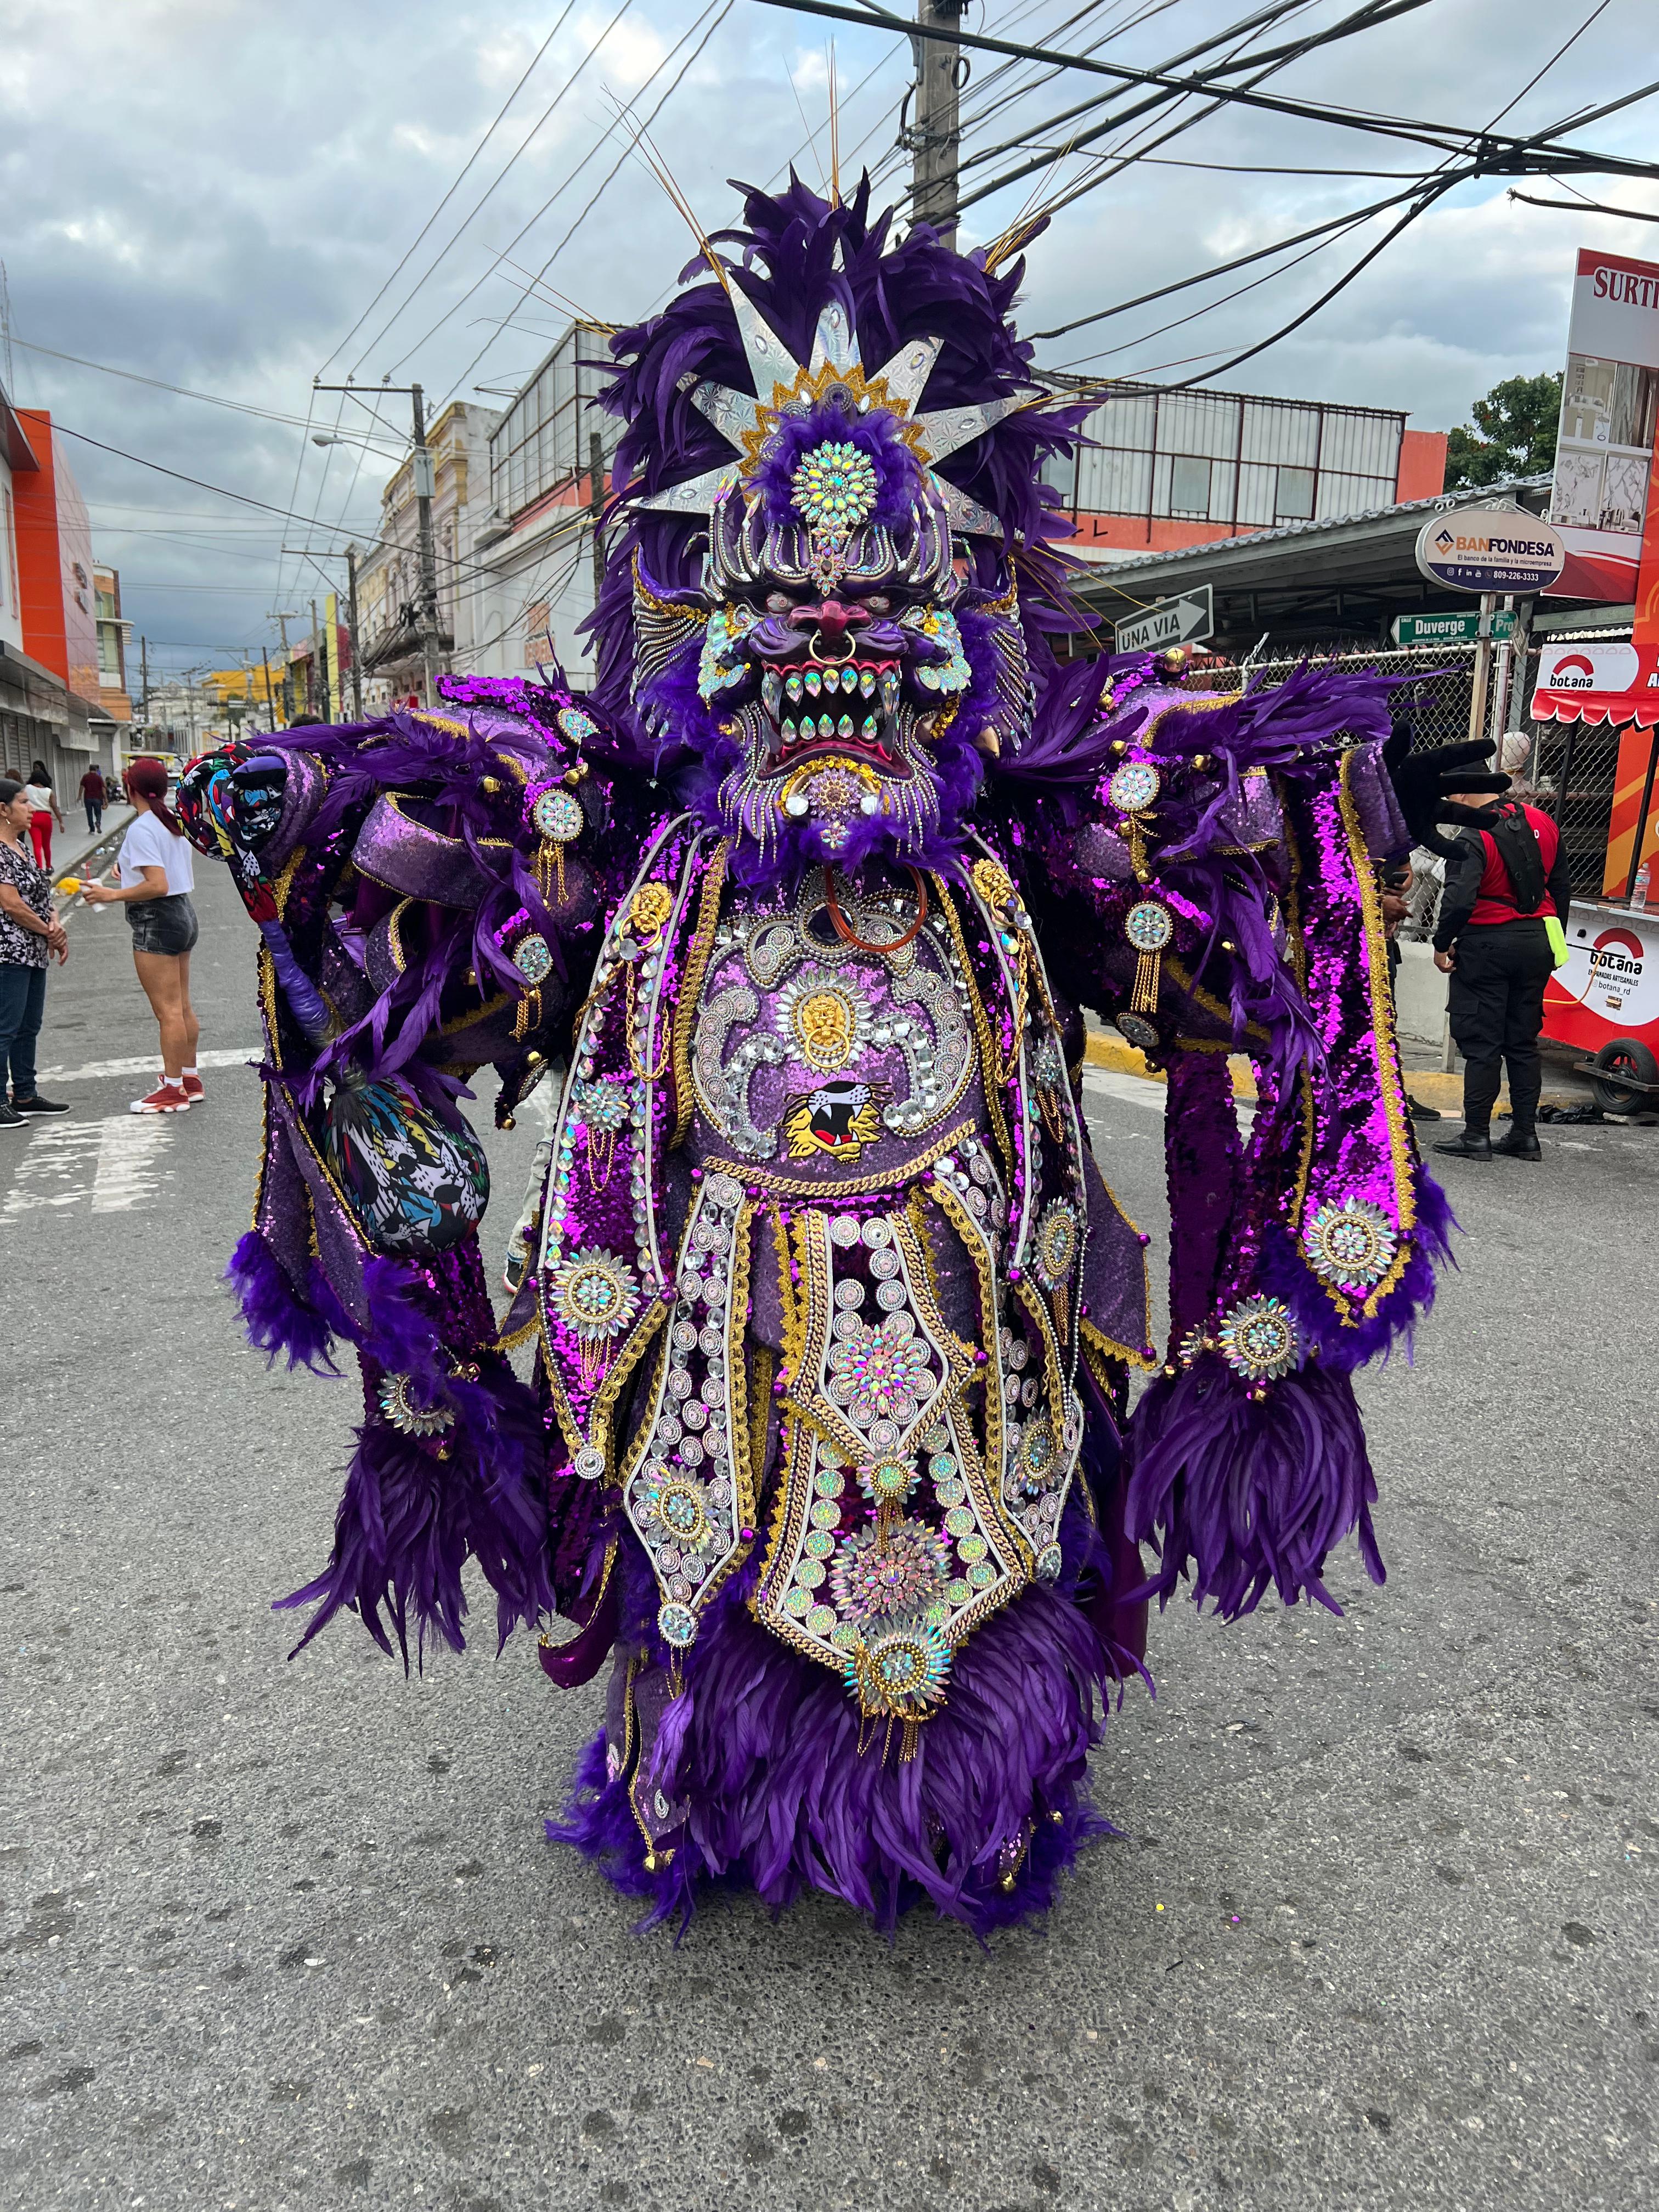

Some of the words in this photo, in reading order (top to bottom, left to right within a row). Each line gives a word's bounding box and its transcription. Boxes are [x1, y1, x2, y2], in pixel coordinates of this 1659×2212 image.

[1456, 537, 1554, 556] BANFONDESA
[1520, 558, 1552, 567] microempresa
[1493, 570, 1539, 582] 809-226-3333
[1122, 625, 1149, 651] UNA
[1154, 613, 1181, 637] VIA
[1415, 619, 1465, 636] Duverge
[1496, 619, 1514, 632] Pro
[1550, 674, 1593, 688] botana
[1589, 950, 1643, 975] botana
[1588, 969, 1612, 980] EPANADAS
[1598, 981, 1631, 996] botana_rd
